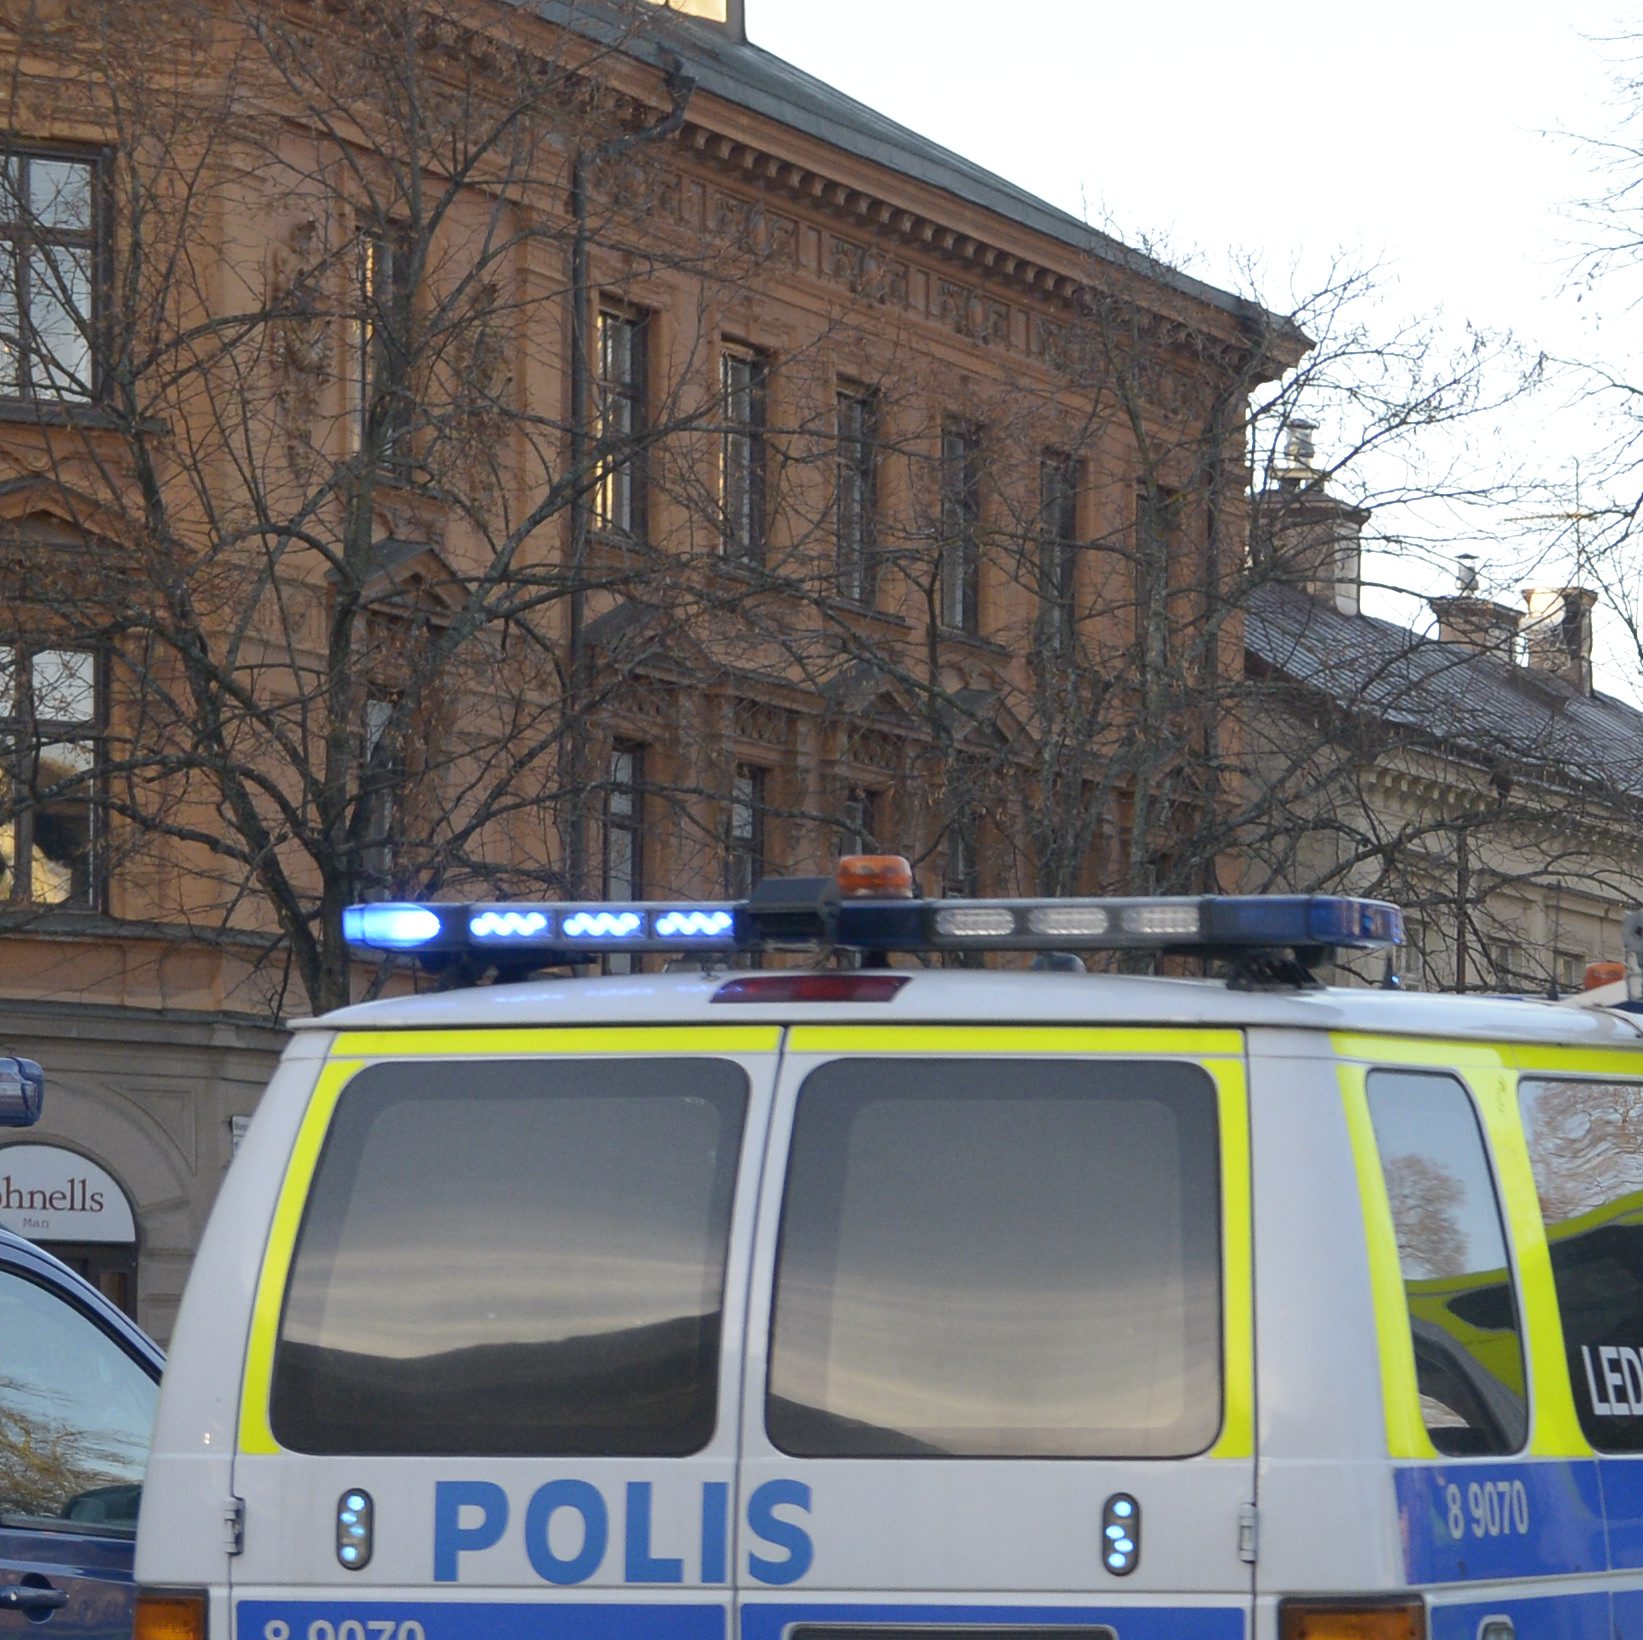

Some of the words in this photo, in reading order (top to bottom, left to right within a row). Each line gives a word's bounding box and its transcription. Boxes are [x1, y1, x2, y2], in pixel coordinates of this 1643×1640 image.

[0, 1175, 104, 1212] hnells
[23, 1218, 49, 1229] Man
[433, 1479, 813, 1585] POLIS
[1446, 1483, 1465, 1539] 8
[1467, 1480, 1529, 1538] 9070
